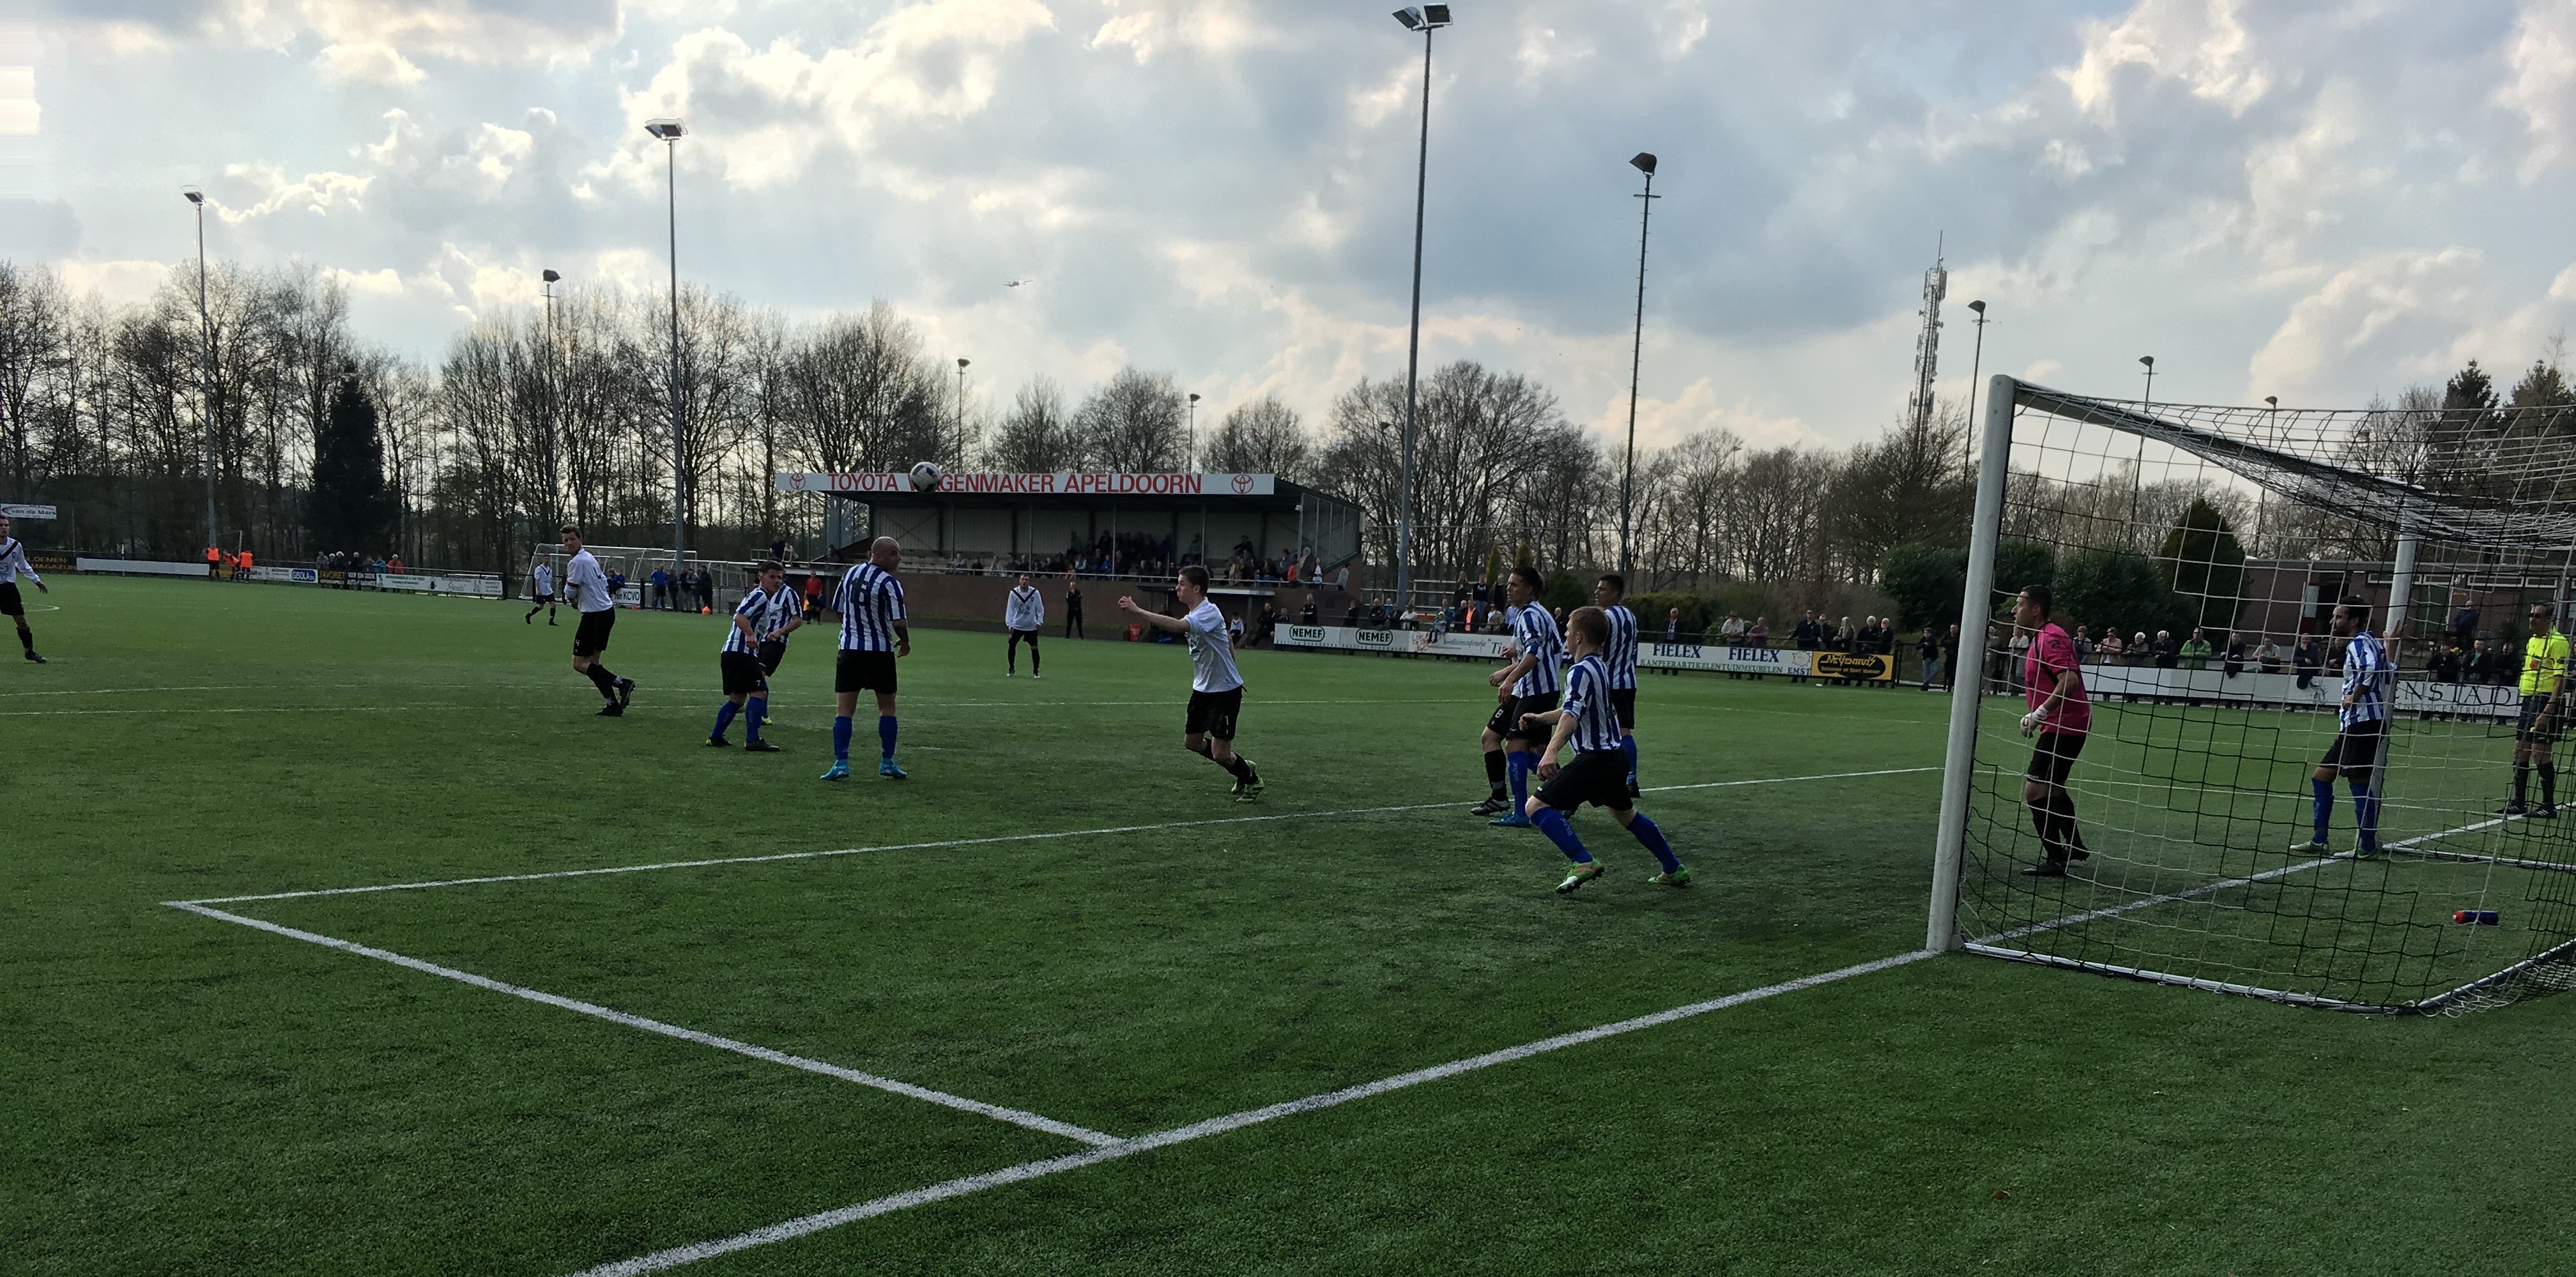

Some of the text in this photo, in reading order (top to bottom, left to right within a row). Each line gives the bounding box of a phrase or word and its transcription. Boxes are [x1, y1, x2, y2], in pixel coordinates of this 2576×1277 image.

[827, 473, 1201, 494] TOYOTA GENMAKER APELDOORN
[623, 591, 640, 601] KCVO
[1292, 628, 1322, 639] NEMEF
[1358, 632, 1390, 643] NEMEF
[1652, 644, 1703, 659] FIELEX
[1728, 647, 1782, 663] FIELEX
[1639, 659, 1721, 671] KAMPEERARTIKELEN
[1787, 667, 1812, 676] EMST
[1495, 708, 1504, 719] 8
